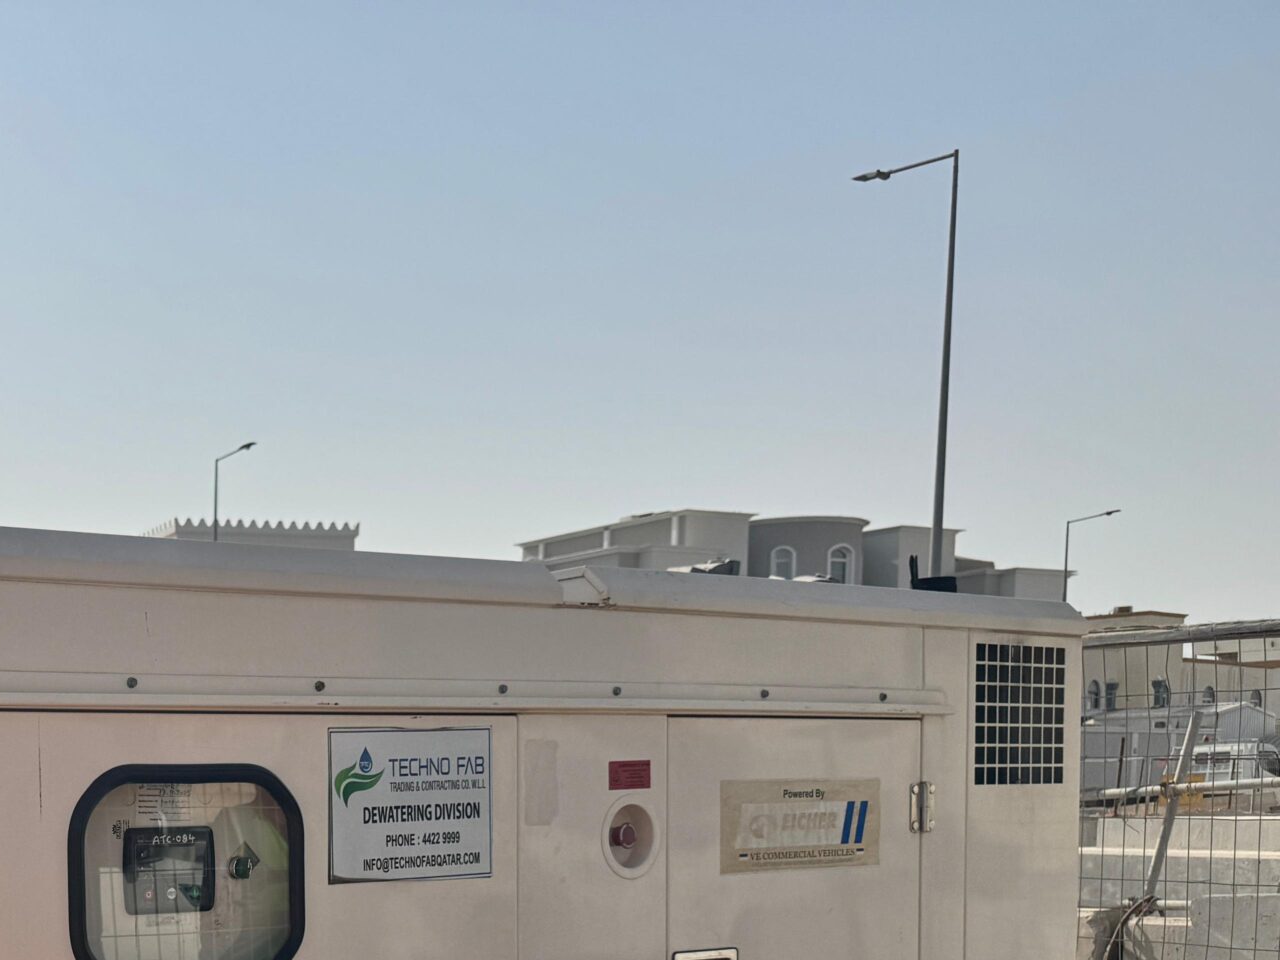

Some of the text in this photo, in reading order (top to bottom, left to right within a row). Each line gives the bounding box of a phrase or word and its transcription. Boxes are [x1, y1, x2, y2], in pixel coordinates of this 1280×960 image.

[388, 757, 451, 778] TECHNO
[456, 756, 485, 776] FAB
[390, 781, 414, 793] TRADING
[421, 779, 460, 792] CONTRACTING
[783, 788, 826, 800] Powered By
[363, 802, 481, 825] DEWATERING DIVISION
[781, 811, 838, 832] EICHER
[385, 833, 416, 848] PHONE
[421, 832, 441, 846] 4422
[442, 831, 461, 845] 9999
[363, 851, 481, 873] INFO@TECHNOFABQATAR.COM
[749, 849, 856, 861] VE COMMERCIAL VEHICLES
